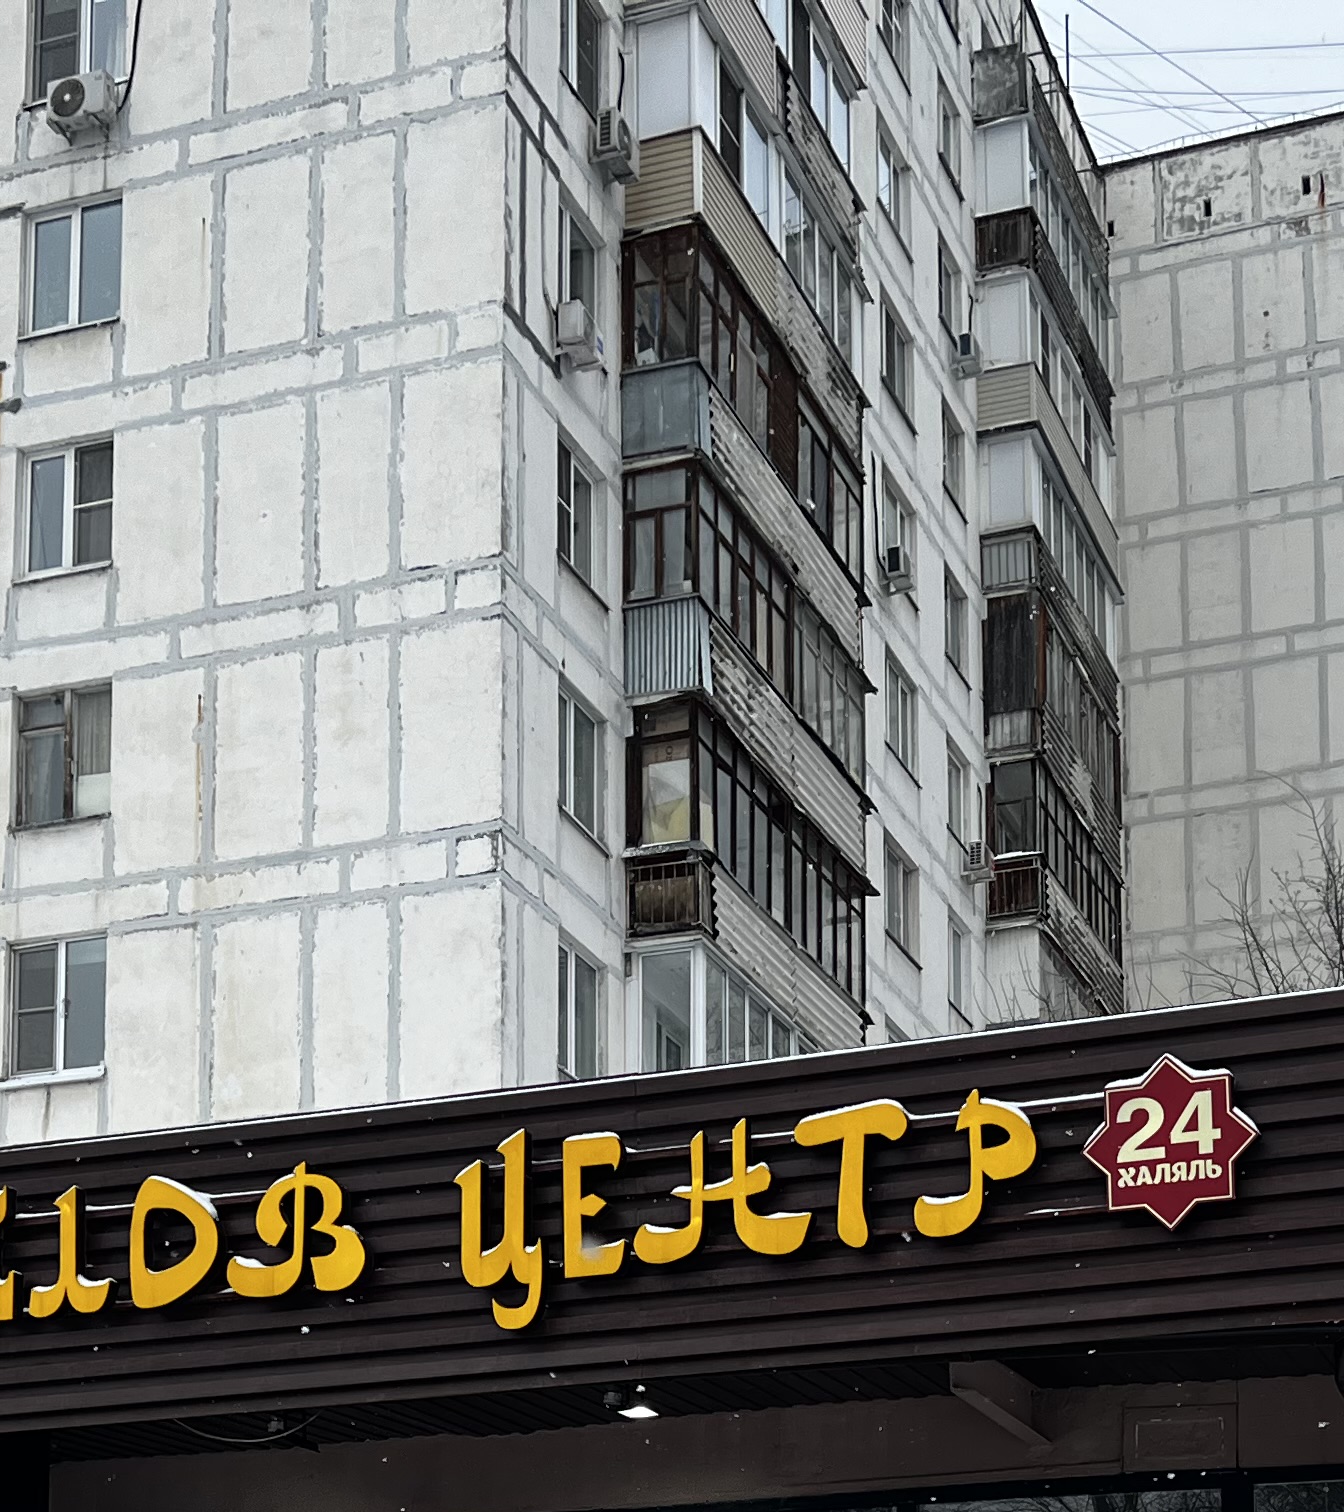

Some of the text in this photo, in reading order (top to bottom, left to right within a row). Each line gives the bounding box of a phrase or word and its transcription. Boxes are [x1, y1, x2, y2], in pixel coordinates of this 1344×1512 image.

[1116, 1090, 1222, 1163] 24
[455, 1087, 1041, 1331] ЦЕНТР
[1117, 1160, 1223, 1188] ХАЛЯЛЬ
